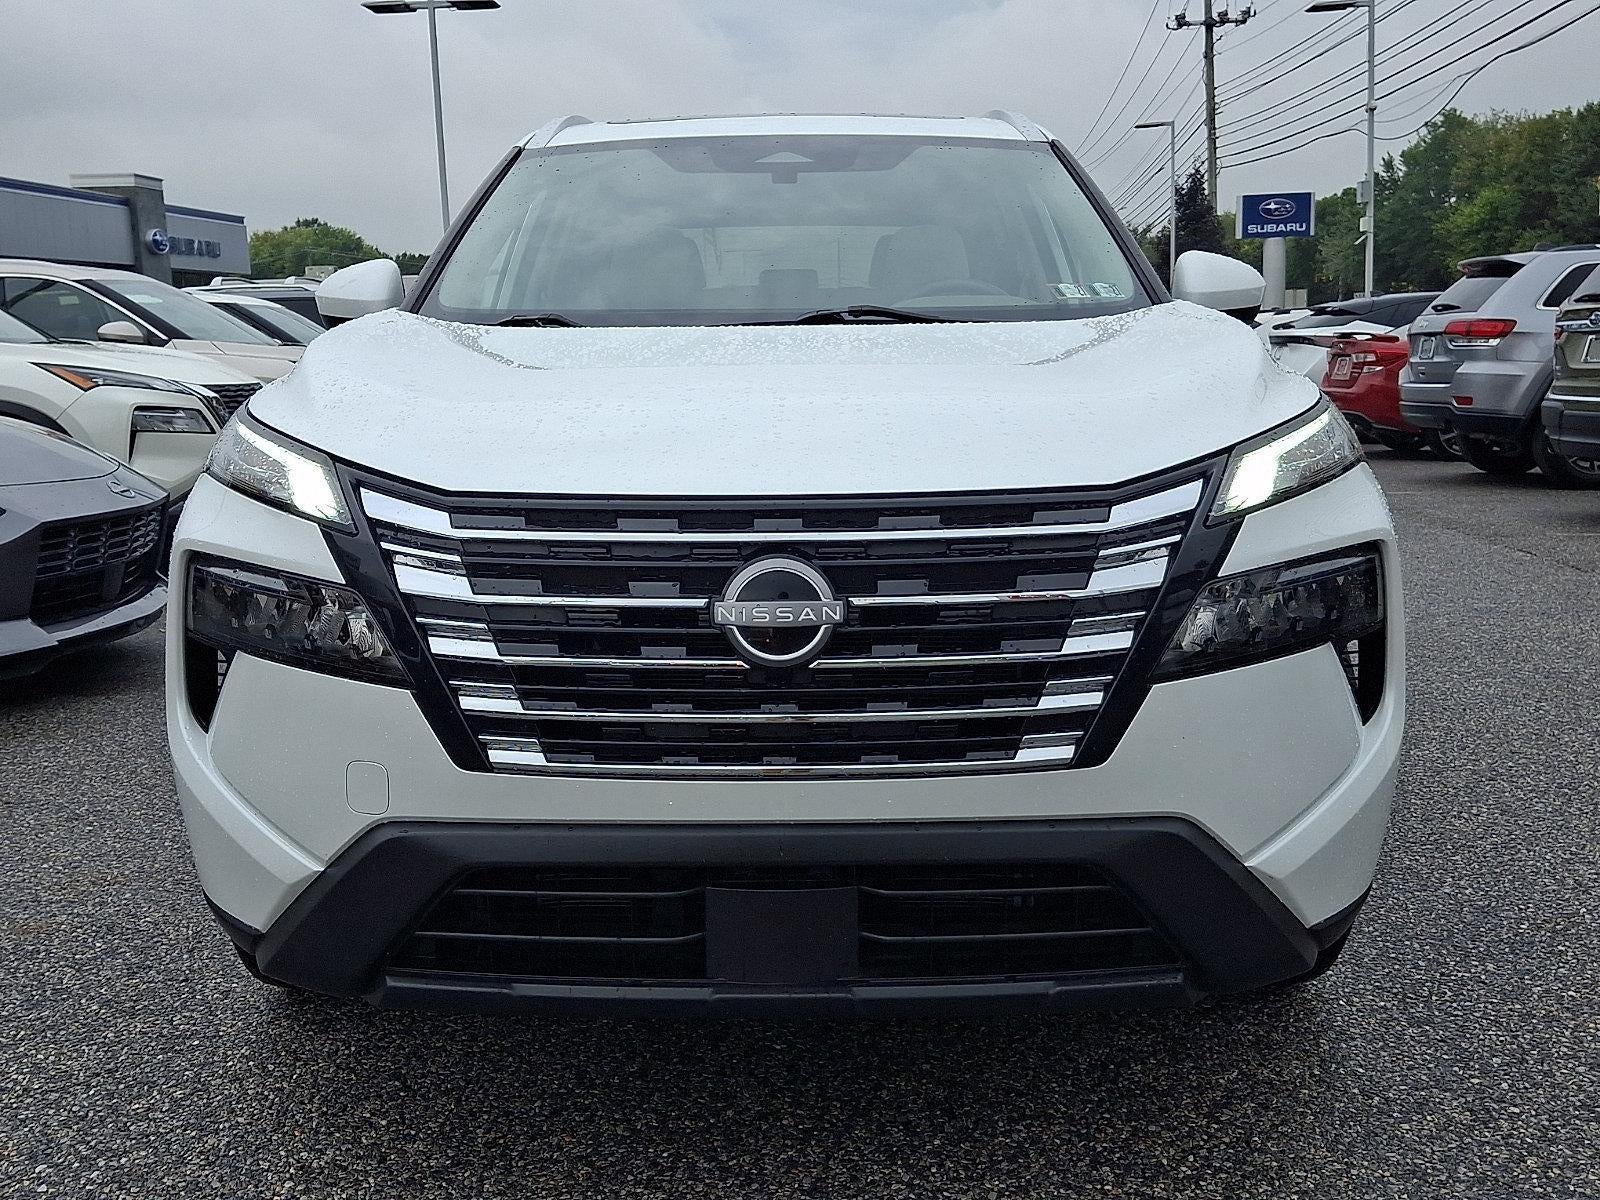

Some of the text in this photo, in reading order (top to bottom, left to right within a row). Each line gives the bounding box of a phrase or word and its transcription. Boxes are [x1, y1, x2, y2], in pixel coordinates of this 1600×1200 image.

[1247, 222, 1307, 234] SUBARU
[169, 236, 221, 258] SUBARU
[717, 606, 840, 622] NISSAN
